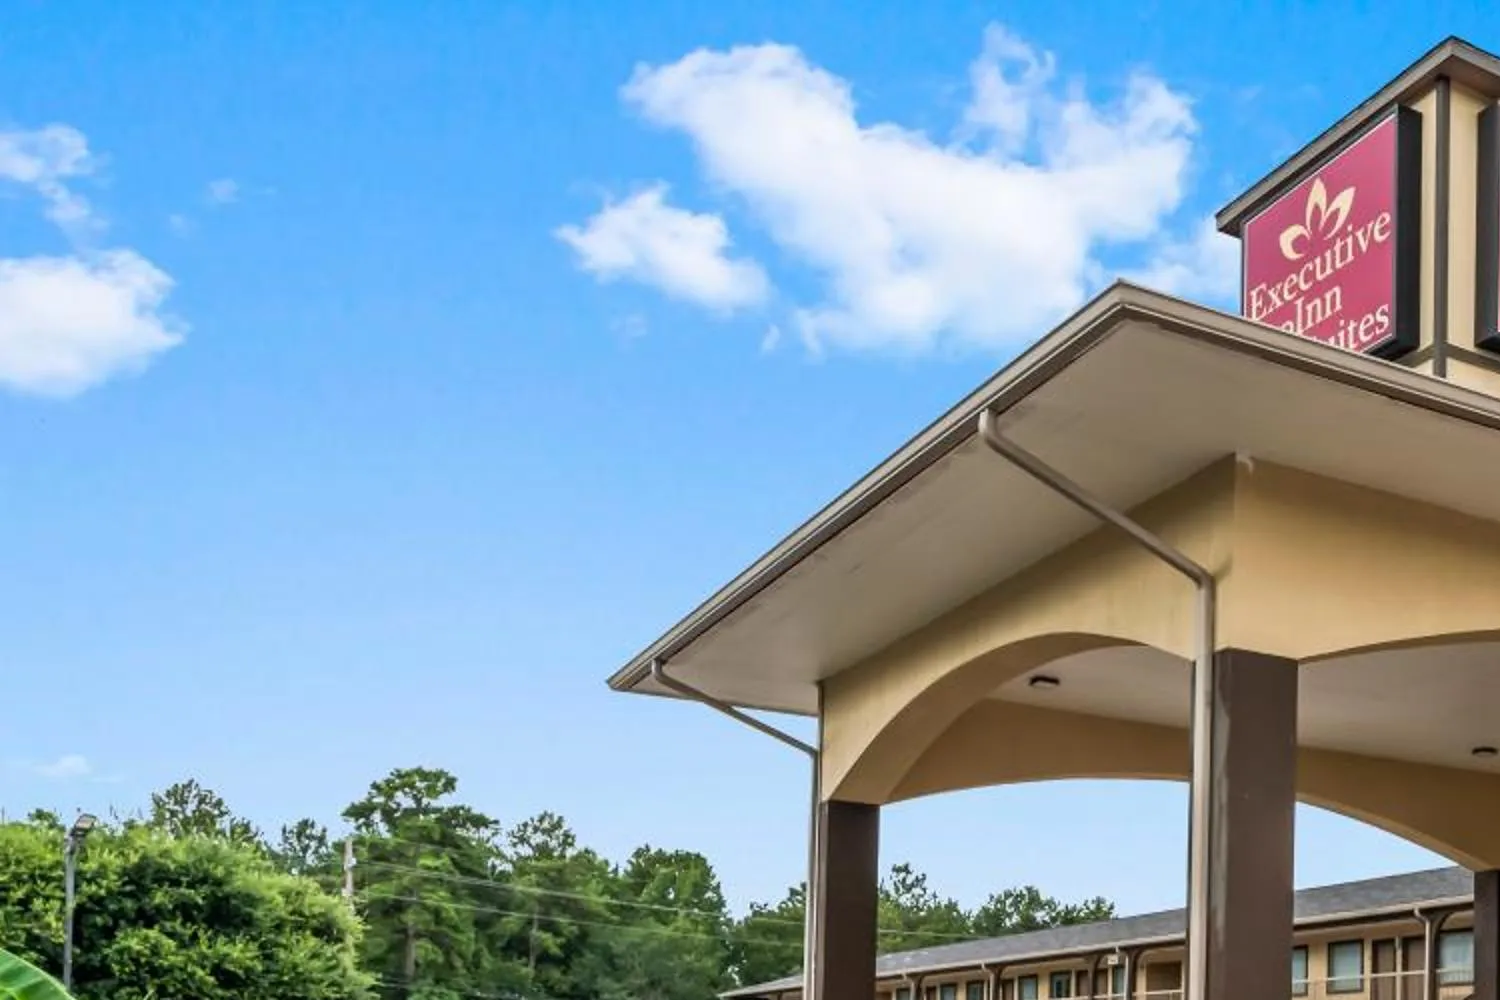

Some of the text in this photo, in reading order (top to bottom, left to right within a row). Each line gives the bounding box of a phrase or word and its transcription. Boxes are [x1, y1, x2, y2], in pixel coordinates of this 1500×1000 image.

[1250, 211, 1392, 322] Executive
[1293, 285, 1343, 334] Inn
[1313, 303, 1390, 349] ites
